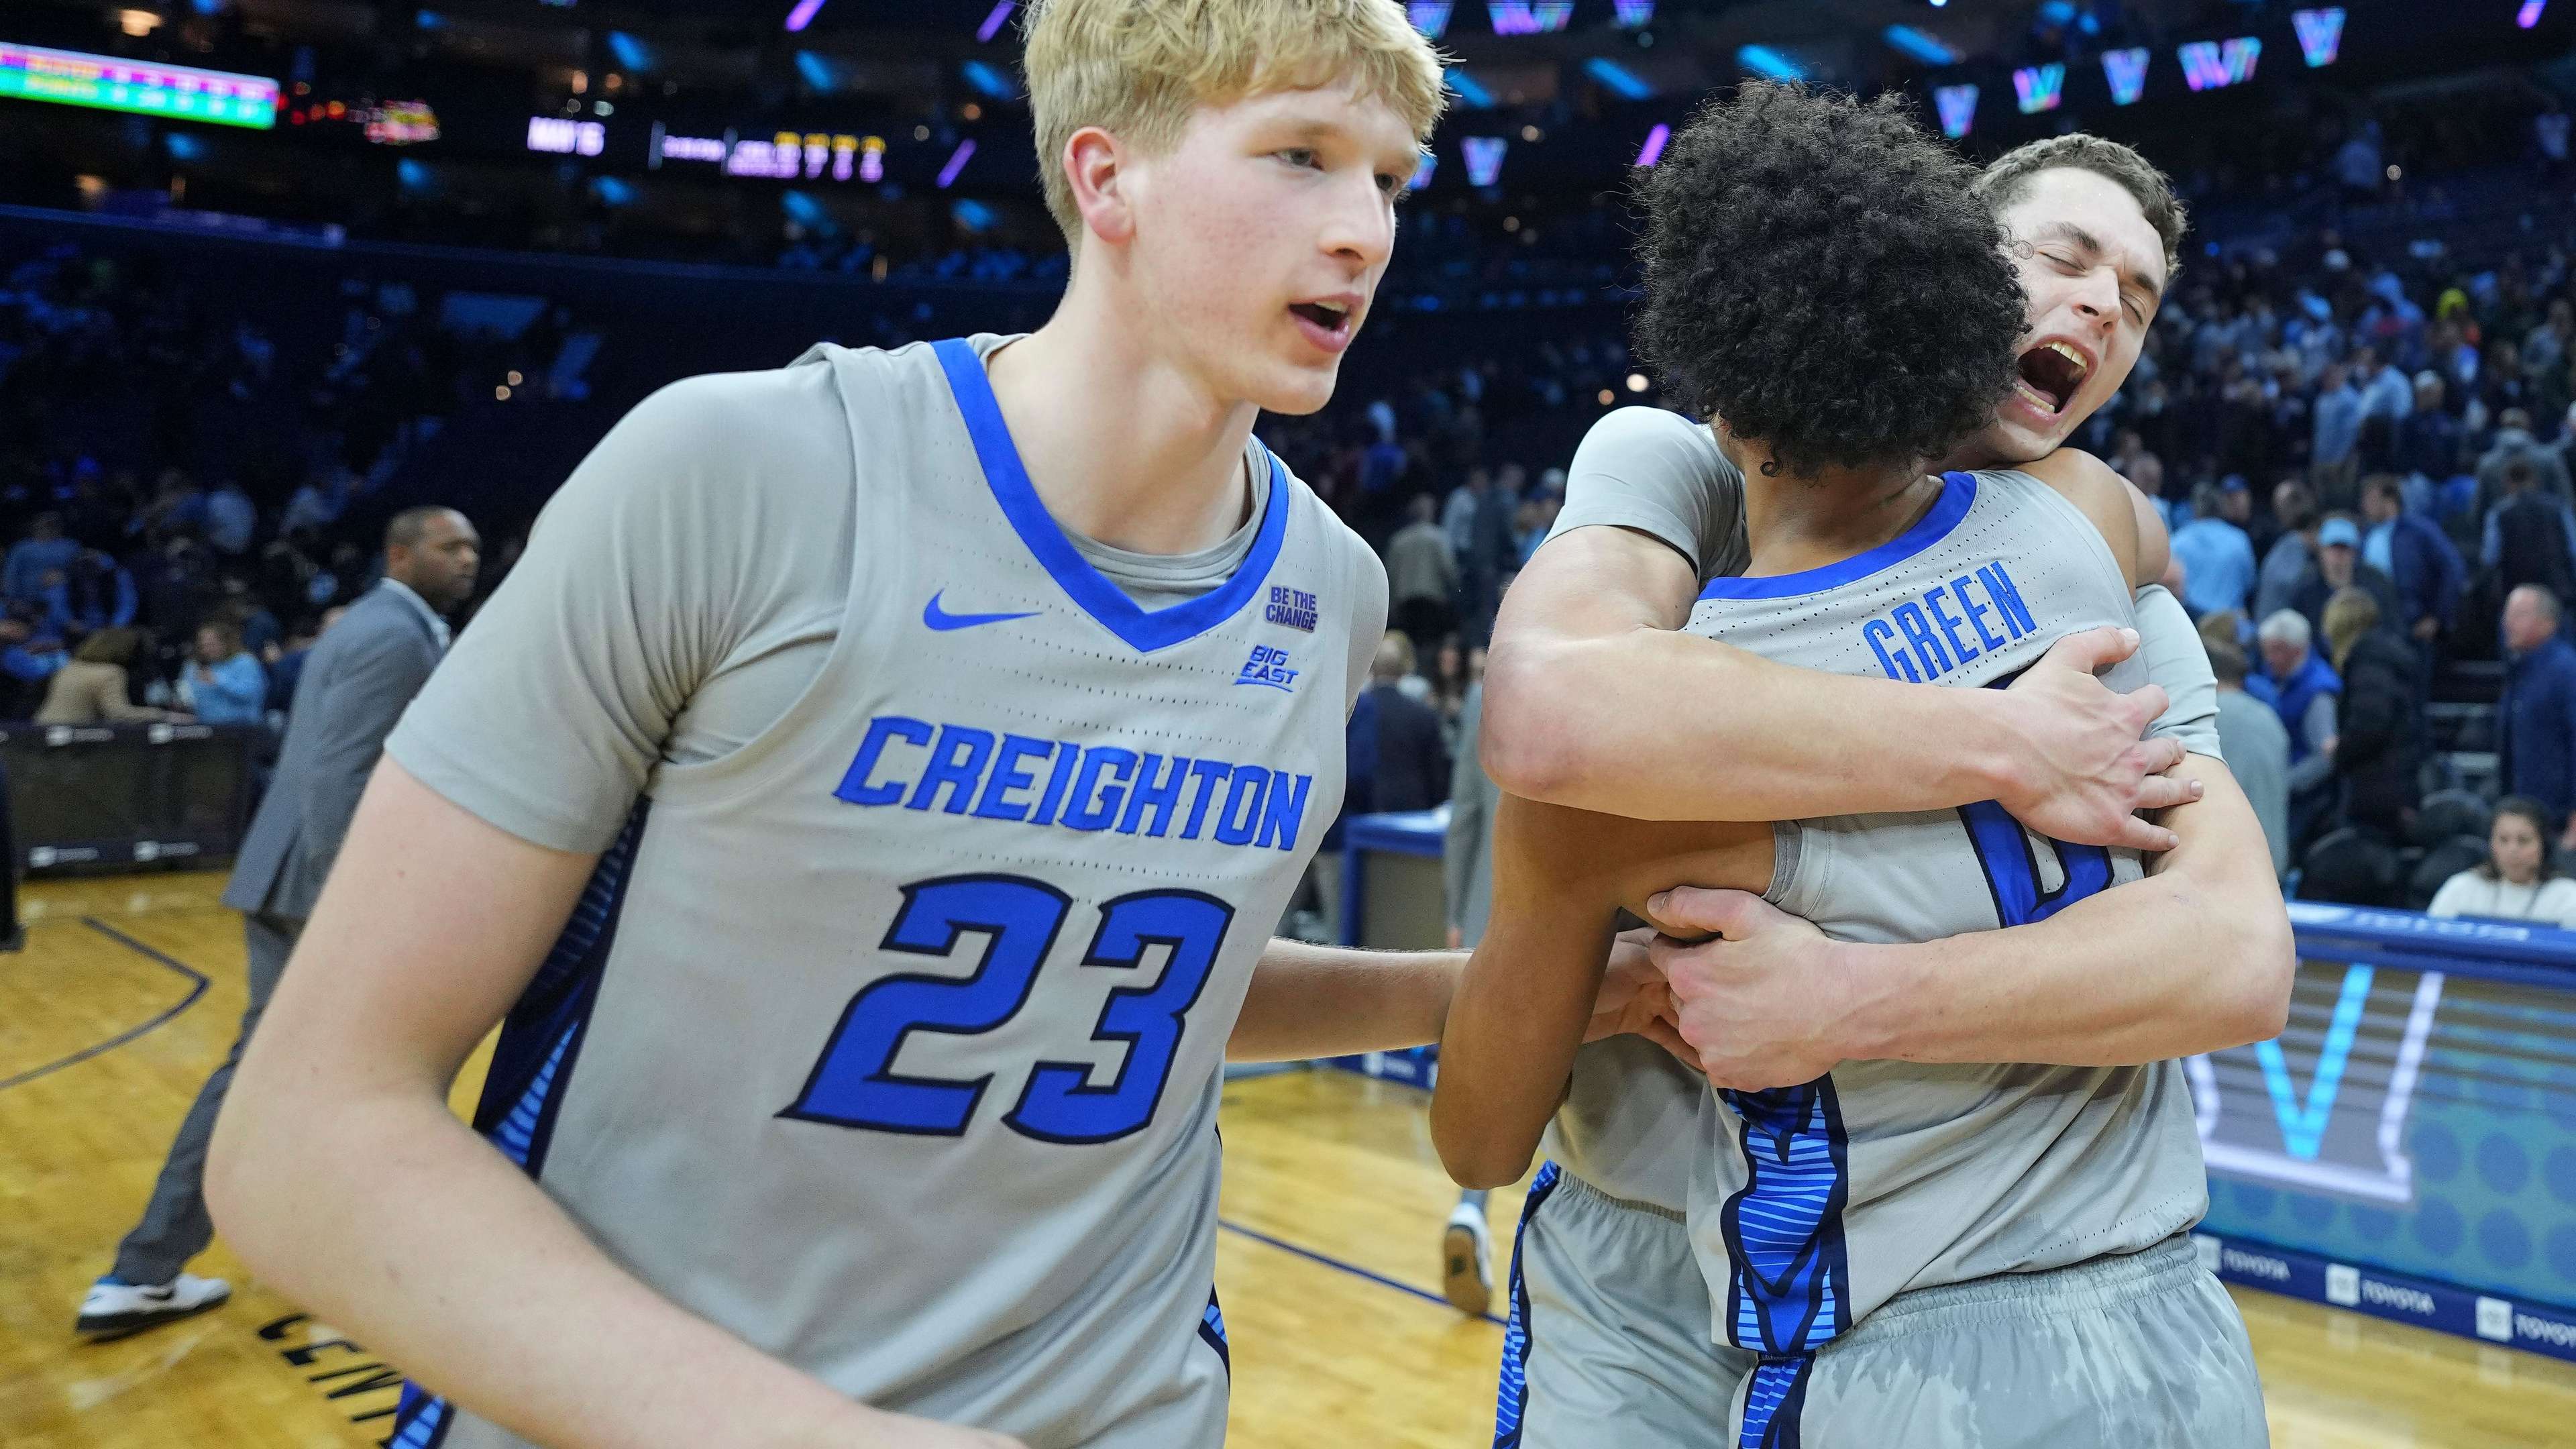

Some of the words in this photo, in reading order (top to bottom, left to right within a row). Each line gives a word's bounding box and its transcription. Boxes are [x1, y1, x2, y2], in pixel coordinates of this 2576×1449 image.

[1271, 586, 1289, 604] BE
[1293, 590, 1316, 611] THE
[1266, 604, 1318, 631] CHANGE
[1862, 560, 2037, 683] GREEN
[1250, 644, 1289, 666] BIG
[1240, 661, 1299, 684] EAST
[832, 715, 1312, 851] CREIGHTON
[773, 872, 1236, 1144] 23
[2223, 1248, 2291, 1281] TOYOTA
[2362, 1279, 2436, 1316] TOYOTA
